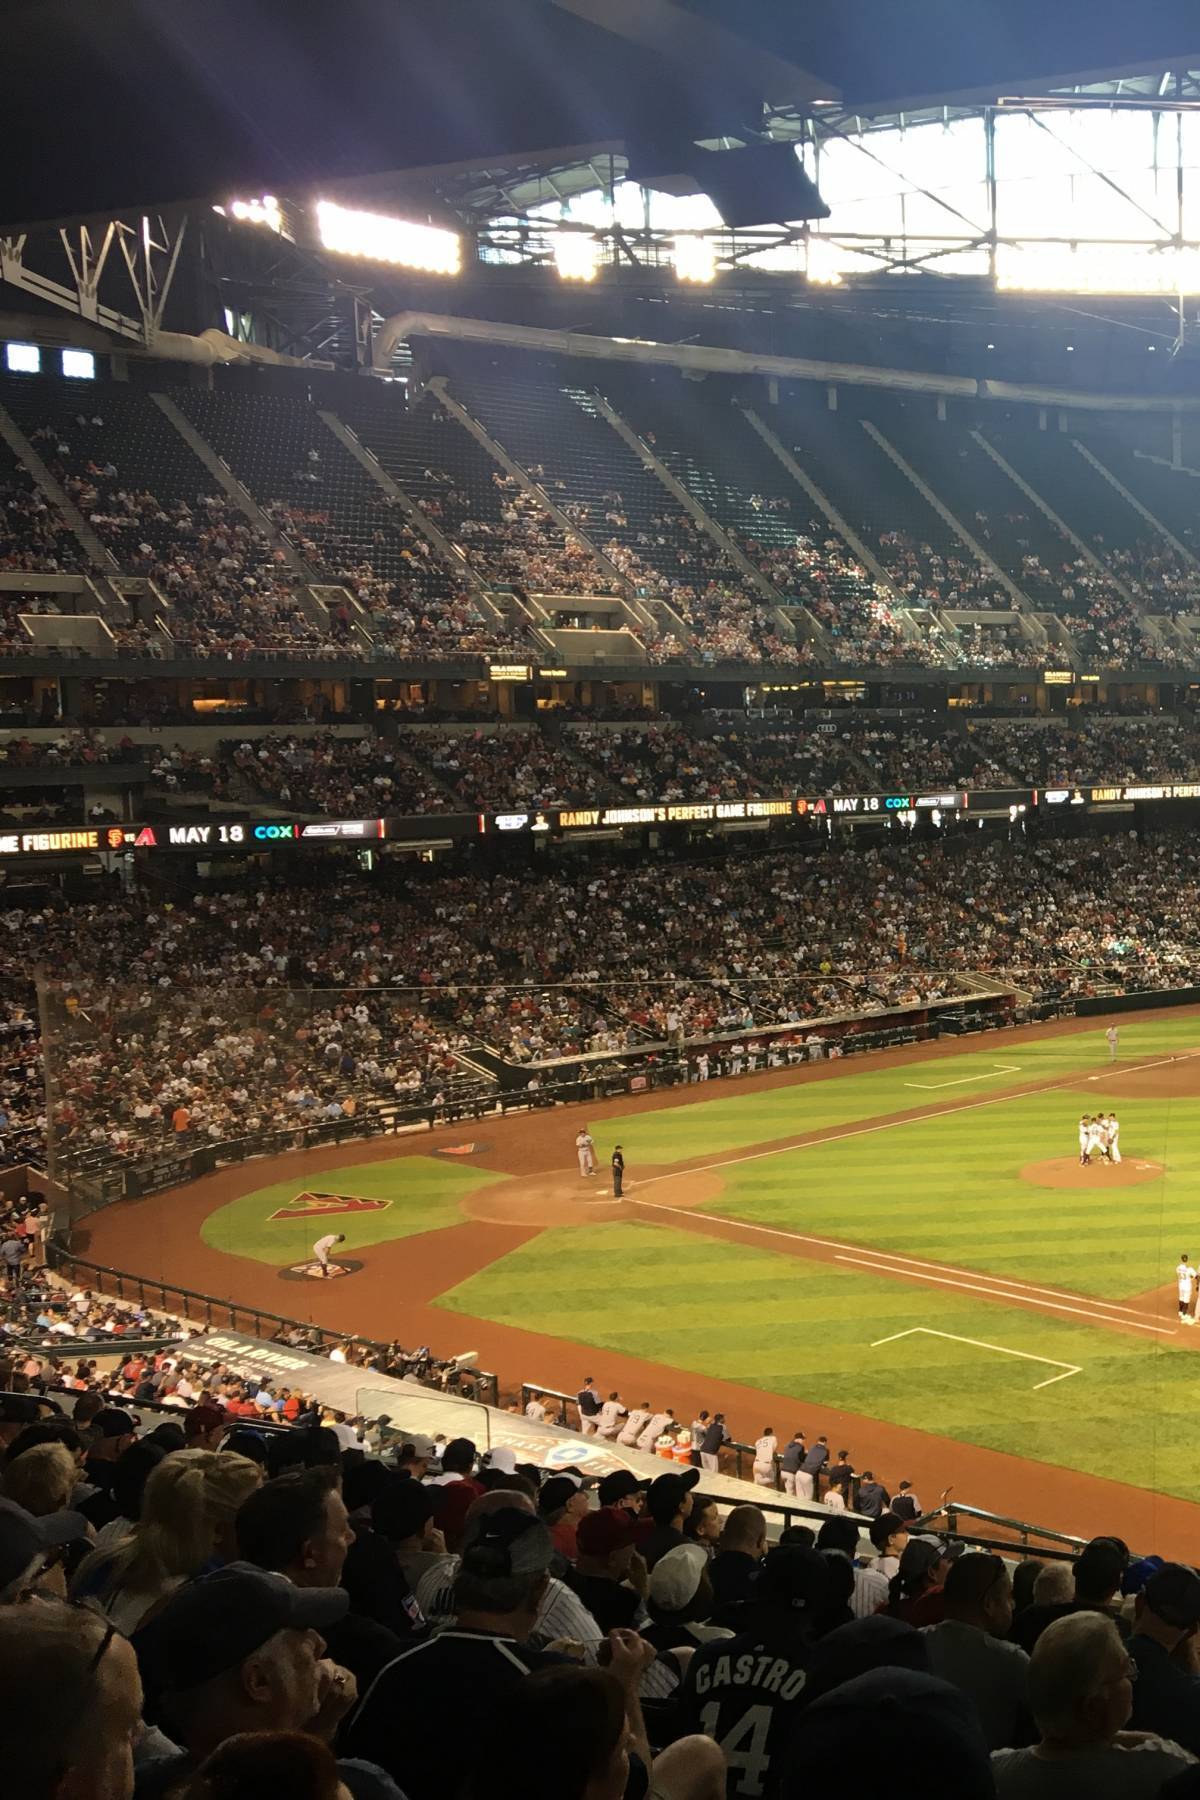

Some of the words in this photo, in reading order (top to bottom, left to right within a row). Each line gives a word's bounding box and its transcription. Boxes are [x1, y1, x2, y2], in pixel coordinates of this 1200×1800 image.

[885, 796, 909, 809] COX
[1092, 788, 1122, 801] RANDY
[1123, 786, 1171, 800] JOHNSON'S
[560, 811, 599, 826] RANDY
[602, 807, 665, 824] JOHNSON'S
[668, 805, 715, 820] PERFECT
[716, 803, 745, 818] GAME
[746, 801, 792, 817] FIGURINE
[833, 798, 858, 812] MAY
[863, 797, 879, 811] 18
[23, 831, 98, 851] FIGURINE
[169, 826, 210, 844] MAY
[218, 825, 243, 842] 18
[254, 825, 292, 839] COX
[205, 1337, 254, 1358] GILA
[247, 1348, 310, 1370] RIVER
[237, 1359, 286, 1376] CASINOS
[696, 1654, 807, 1700] CASTRO
